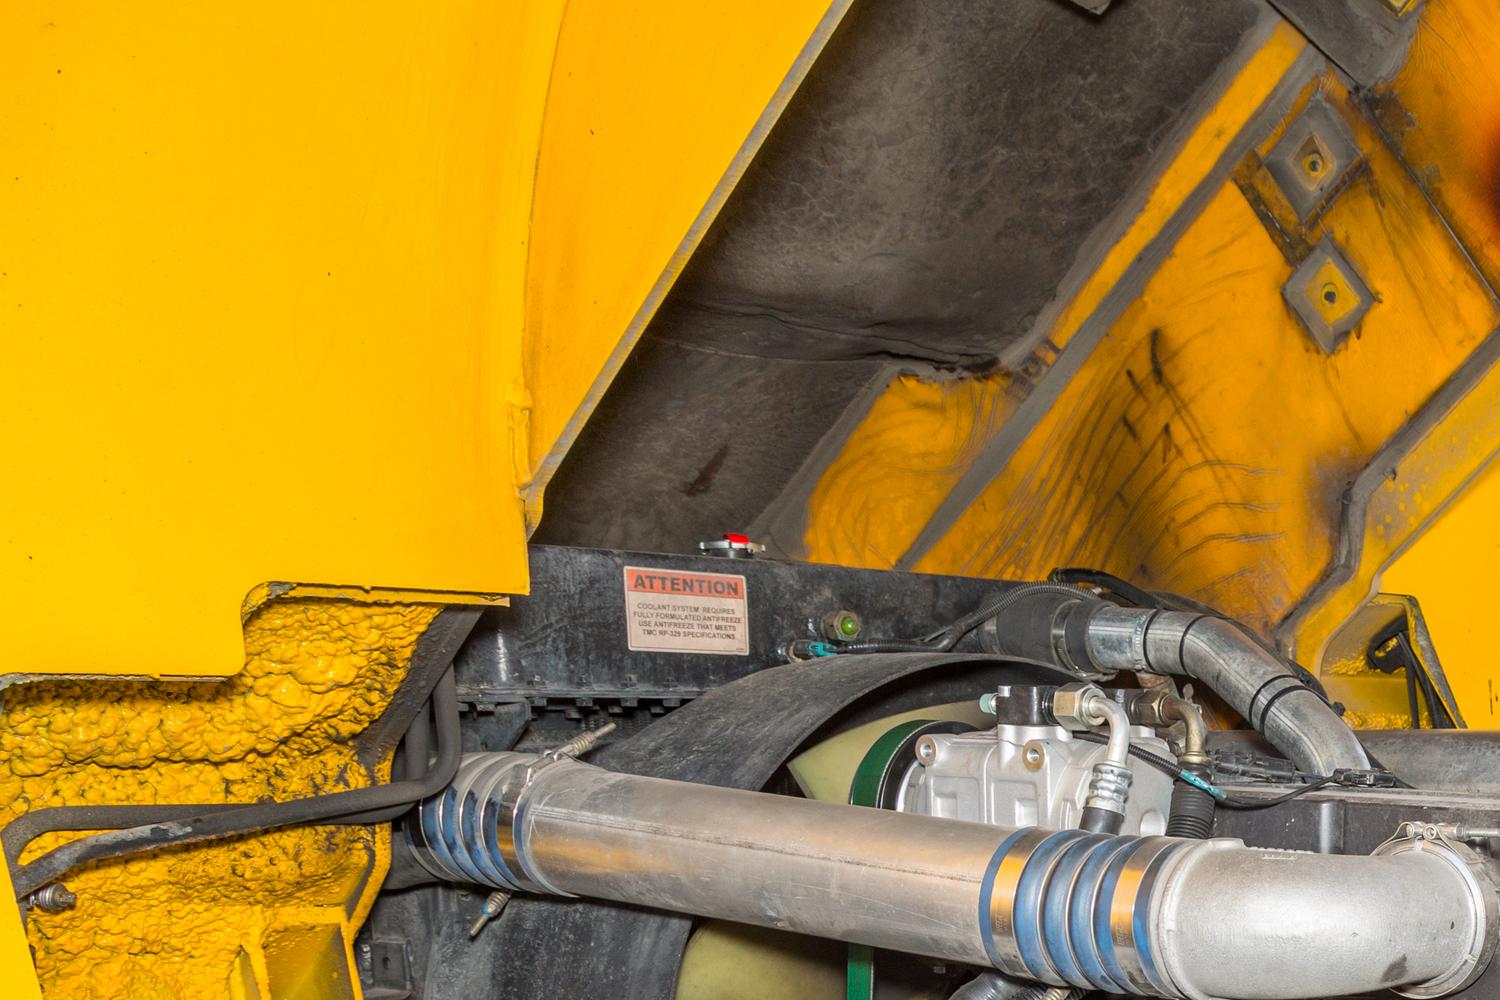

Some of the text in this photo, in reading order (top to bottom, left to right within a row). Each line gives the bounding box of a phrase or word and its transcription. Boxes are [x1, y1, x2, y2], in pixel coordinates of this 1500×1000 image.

[634, 575, 738, 595] ATTENTION
[637, 602, 670, 611] COOLANT
[702, 607, 736, 615] REQUIRES
[656, 613, 702, 621] FORMULATED
[703, 615, 742, 623] ANTIFREEZE
[654, 621, 695, 630] ANTIFREEZE
[715, 624, 736, 632] MEETS
[683, 631, 736, 640] SPECIFICATIONS
